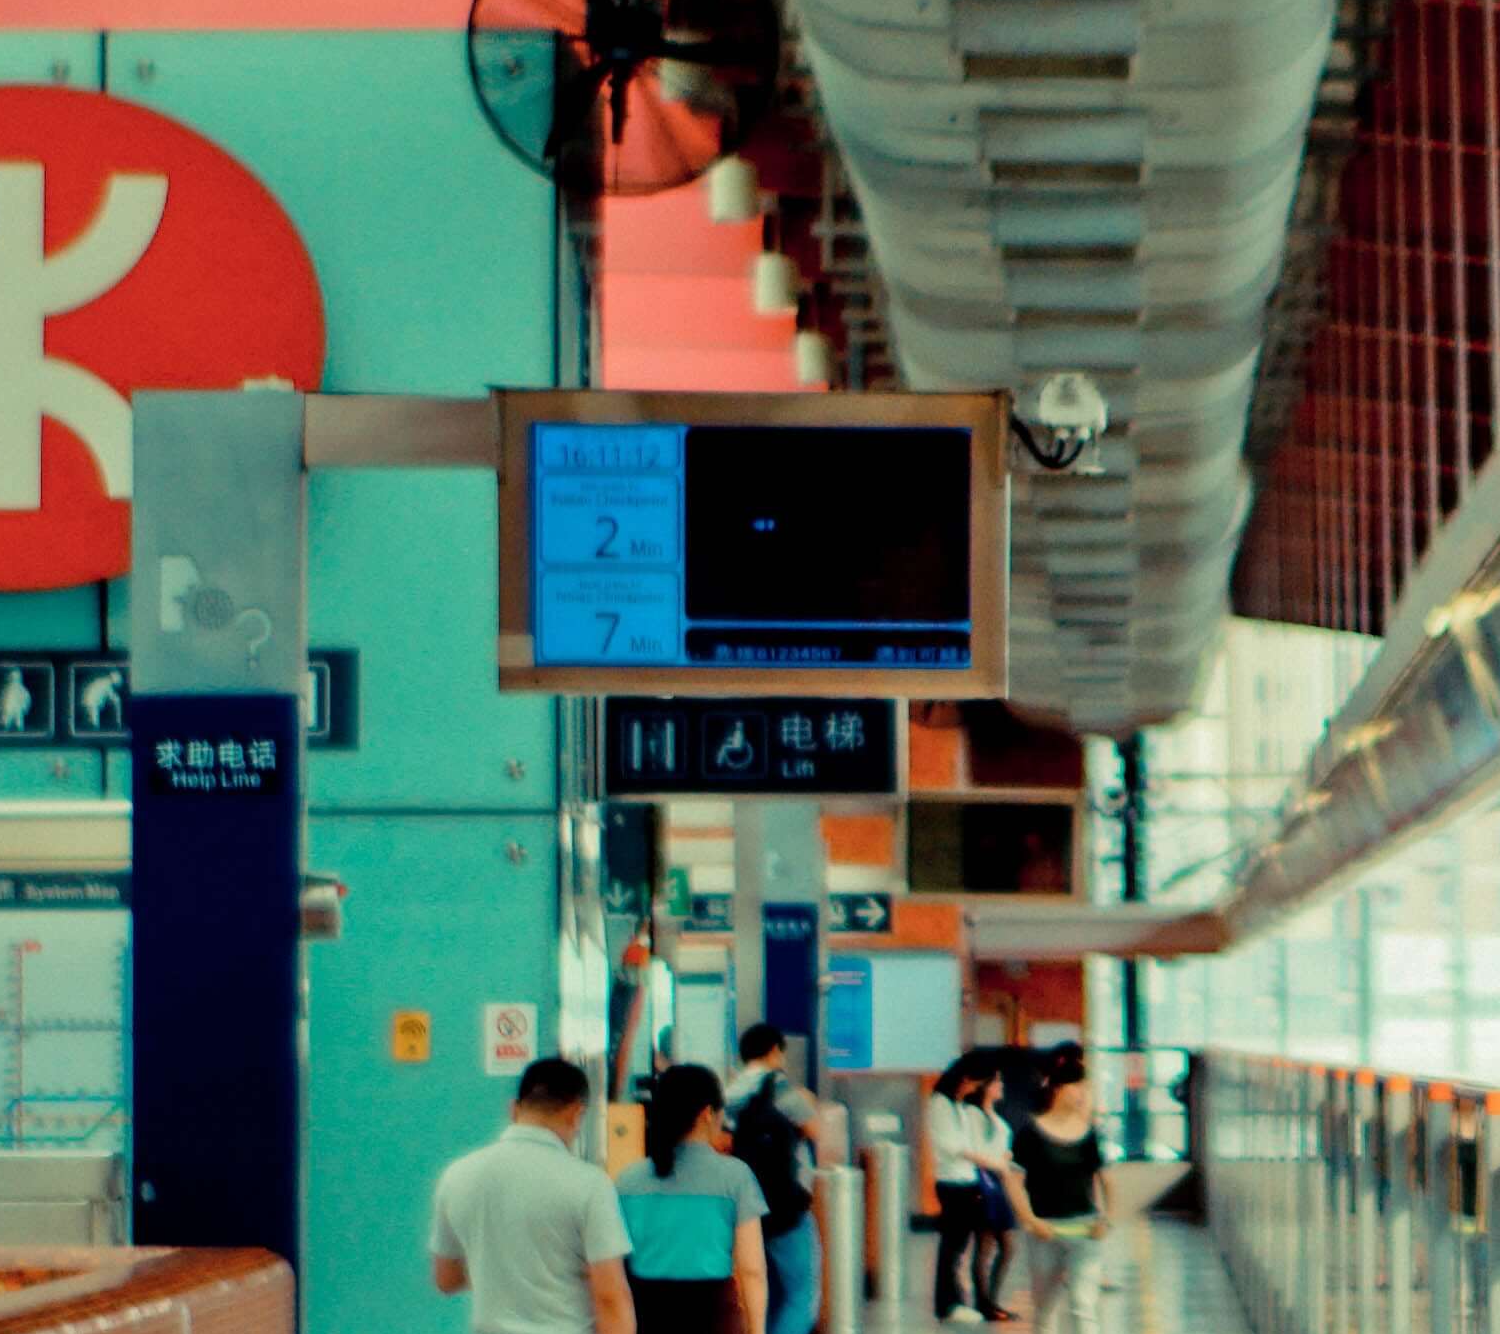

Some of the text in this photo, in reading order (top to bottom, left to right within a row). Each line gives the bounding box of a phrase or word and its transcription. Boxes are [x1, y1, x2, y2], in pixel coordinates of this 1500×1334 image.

[595, 515, 663, 559] 2 Min
[595, 613, 663, 655] 7 Min
[780, 712, 866, 752] 电梯
[155, 738, 276, 770] 求助电话
[171, 769, 262, 793] Help Line
